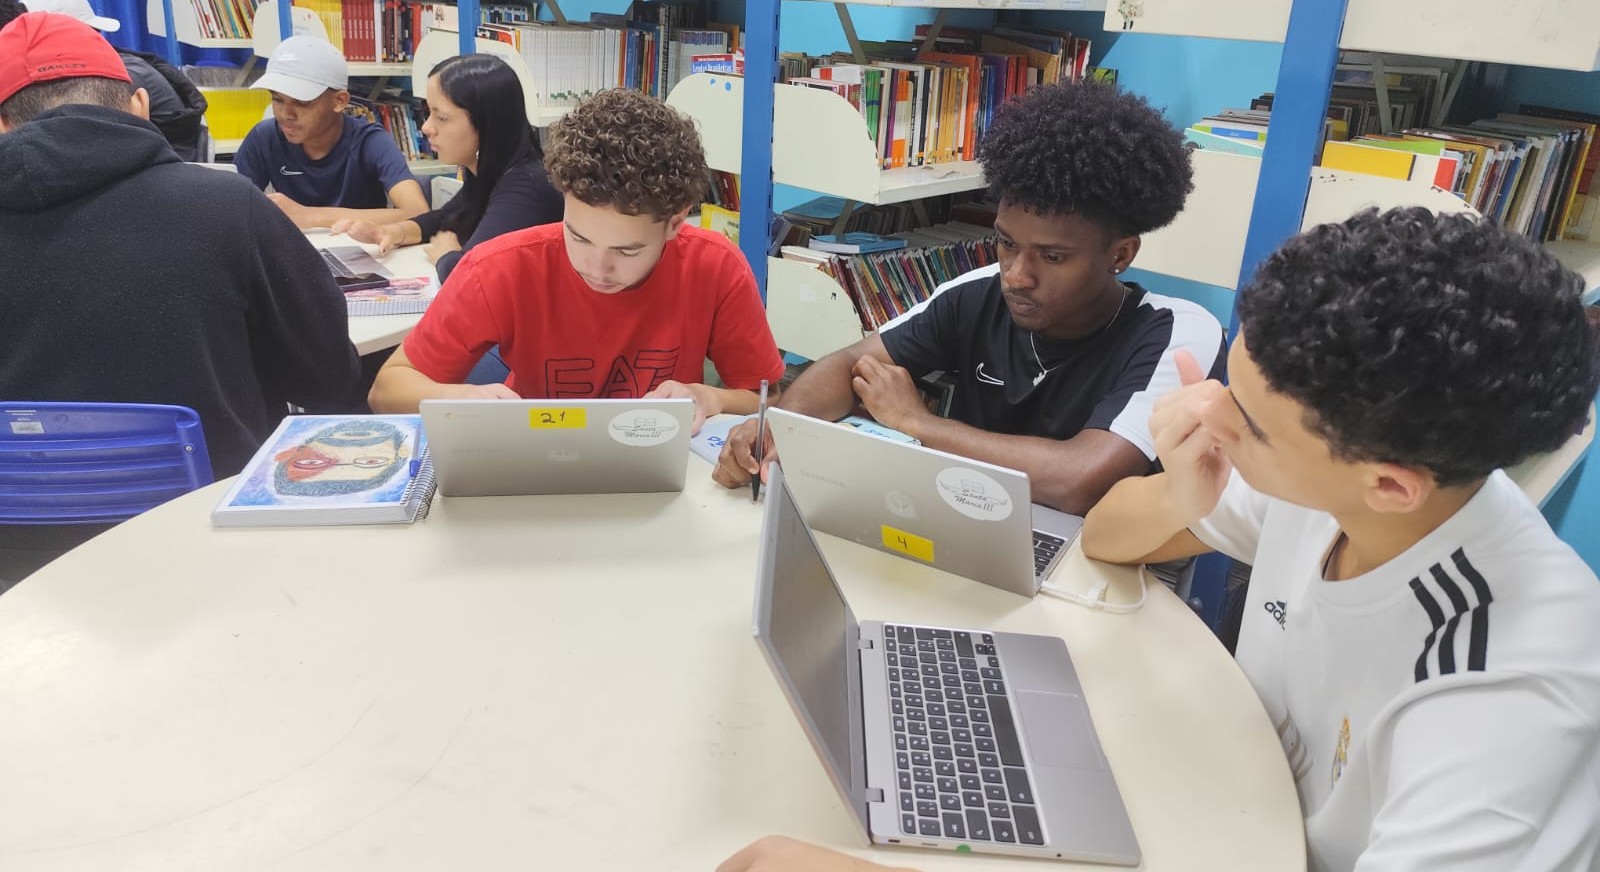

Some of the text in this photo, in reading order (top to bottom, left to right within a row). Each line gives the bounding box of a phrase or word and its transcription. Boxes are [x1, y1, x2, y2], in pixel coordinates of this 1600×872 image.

[38, 63, 86, 73] OAKLEY
[540, 410, 565, 424] 21
[953, 495, 982, 508] Maria
[961, 489, 987, 501] Santa
[897, 535, 907, 549] 4
